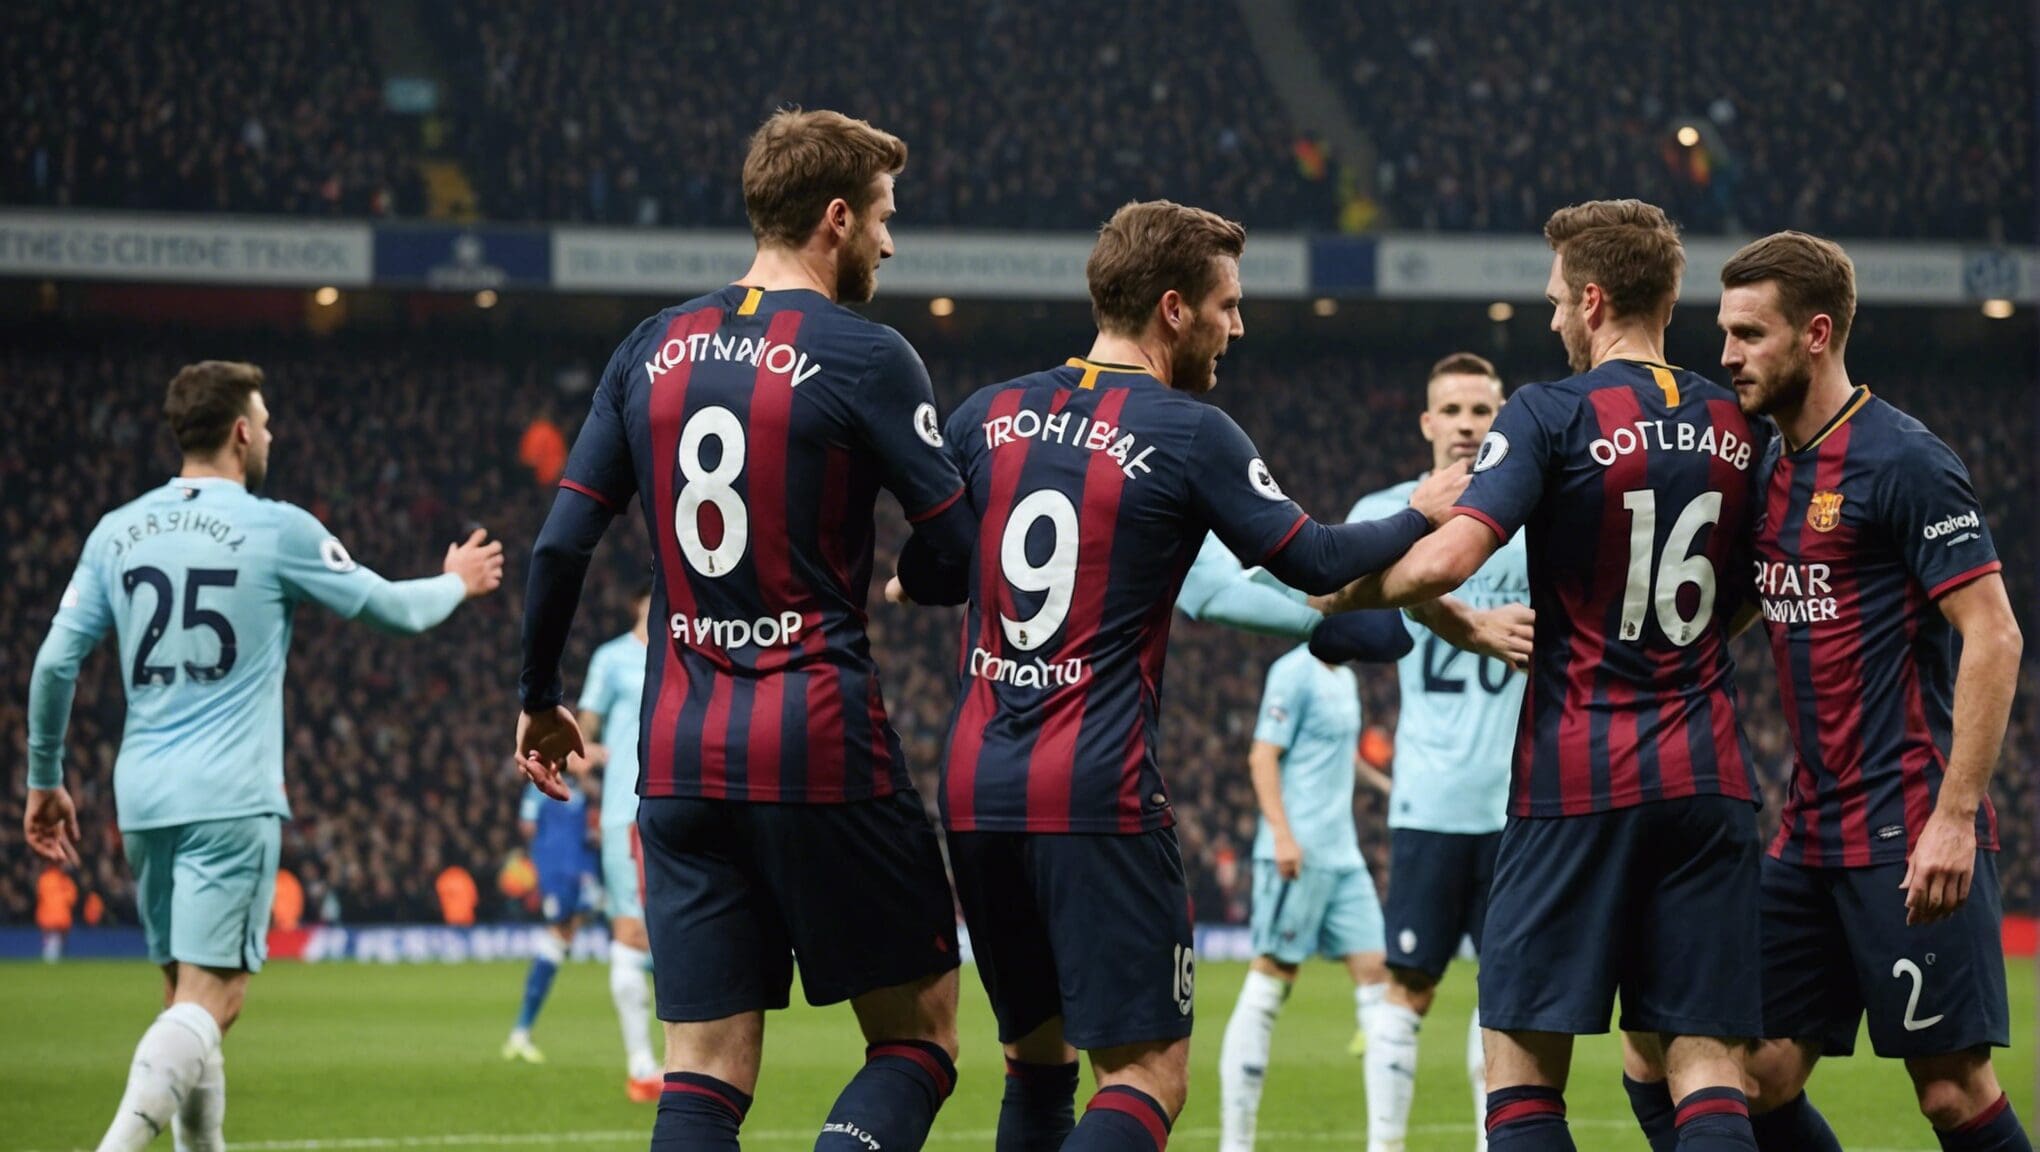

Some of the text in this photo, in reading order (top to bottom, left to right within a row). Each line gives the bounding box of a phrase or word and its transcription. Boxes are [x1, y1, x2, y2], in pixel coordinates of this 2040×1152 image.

[675, 405, 748, 578] 8
[1001, 489, 1080, 651] 9
[1619, 488, 1723, 647] 16
[122, 565, 237, 688] 25
[1892, 958, 1945, 1032] 2
